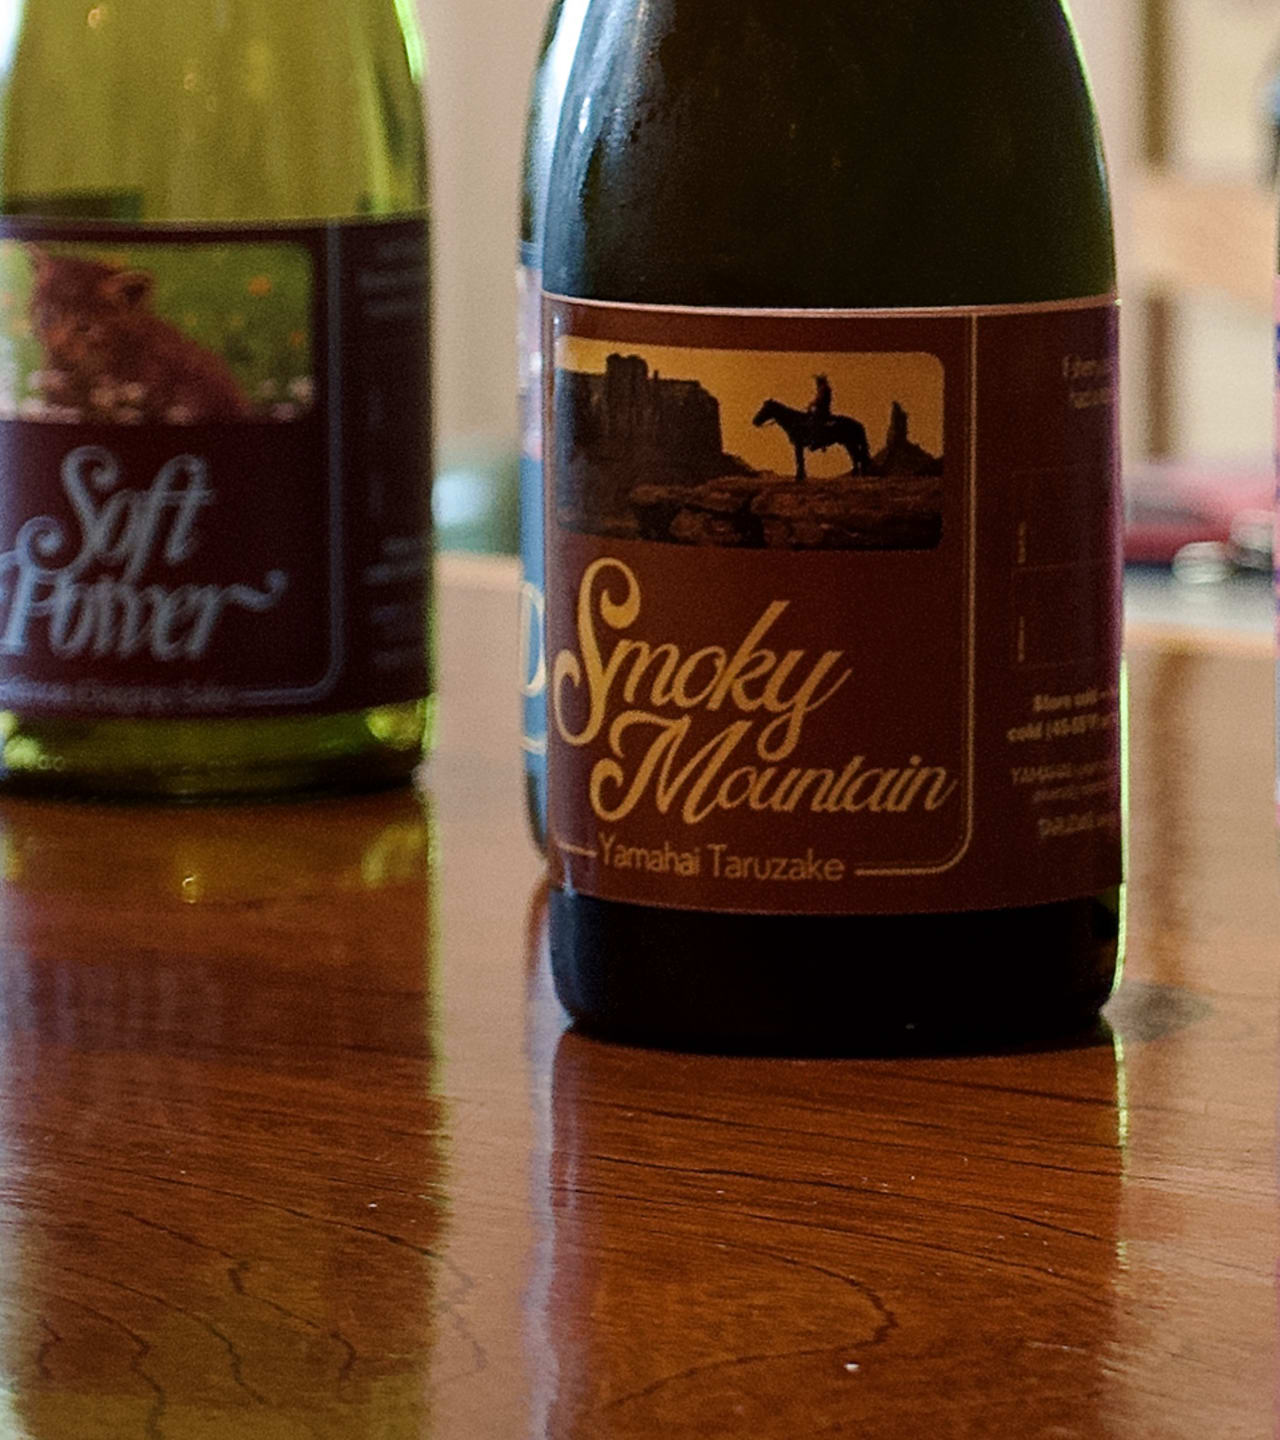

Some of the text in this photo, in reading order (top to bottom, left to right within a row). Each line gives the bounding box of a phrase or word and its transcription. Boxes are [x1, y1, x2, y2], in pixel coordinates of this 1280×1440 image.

[15, 444, 218, 587] Soft
[0, 548, 289, 661] Power
[553, 557, 852, 761] Smoky
[589, 709, 959, 825] Mountain
[598, 831, 846, 882] Yamahai Taruzake
